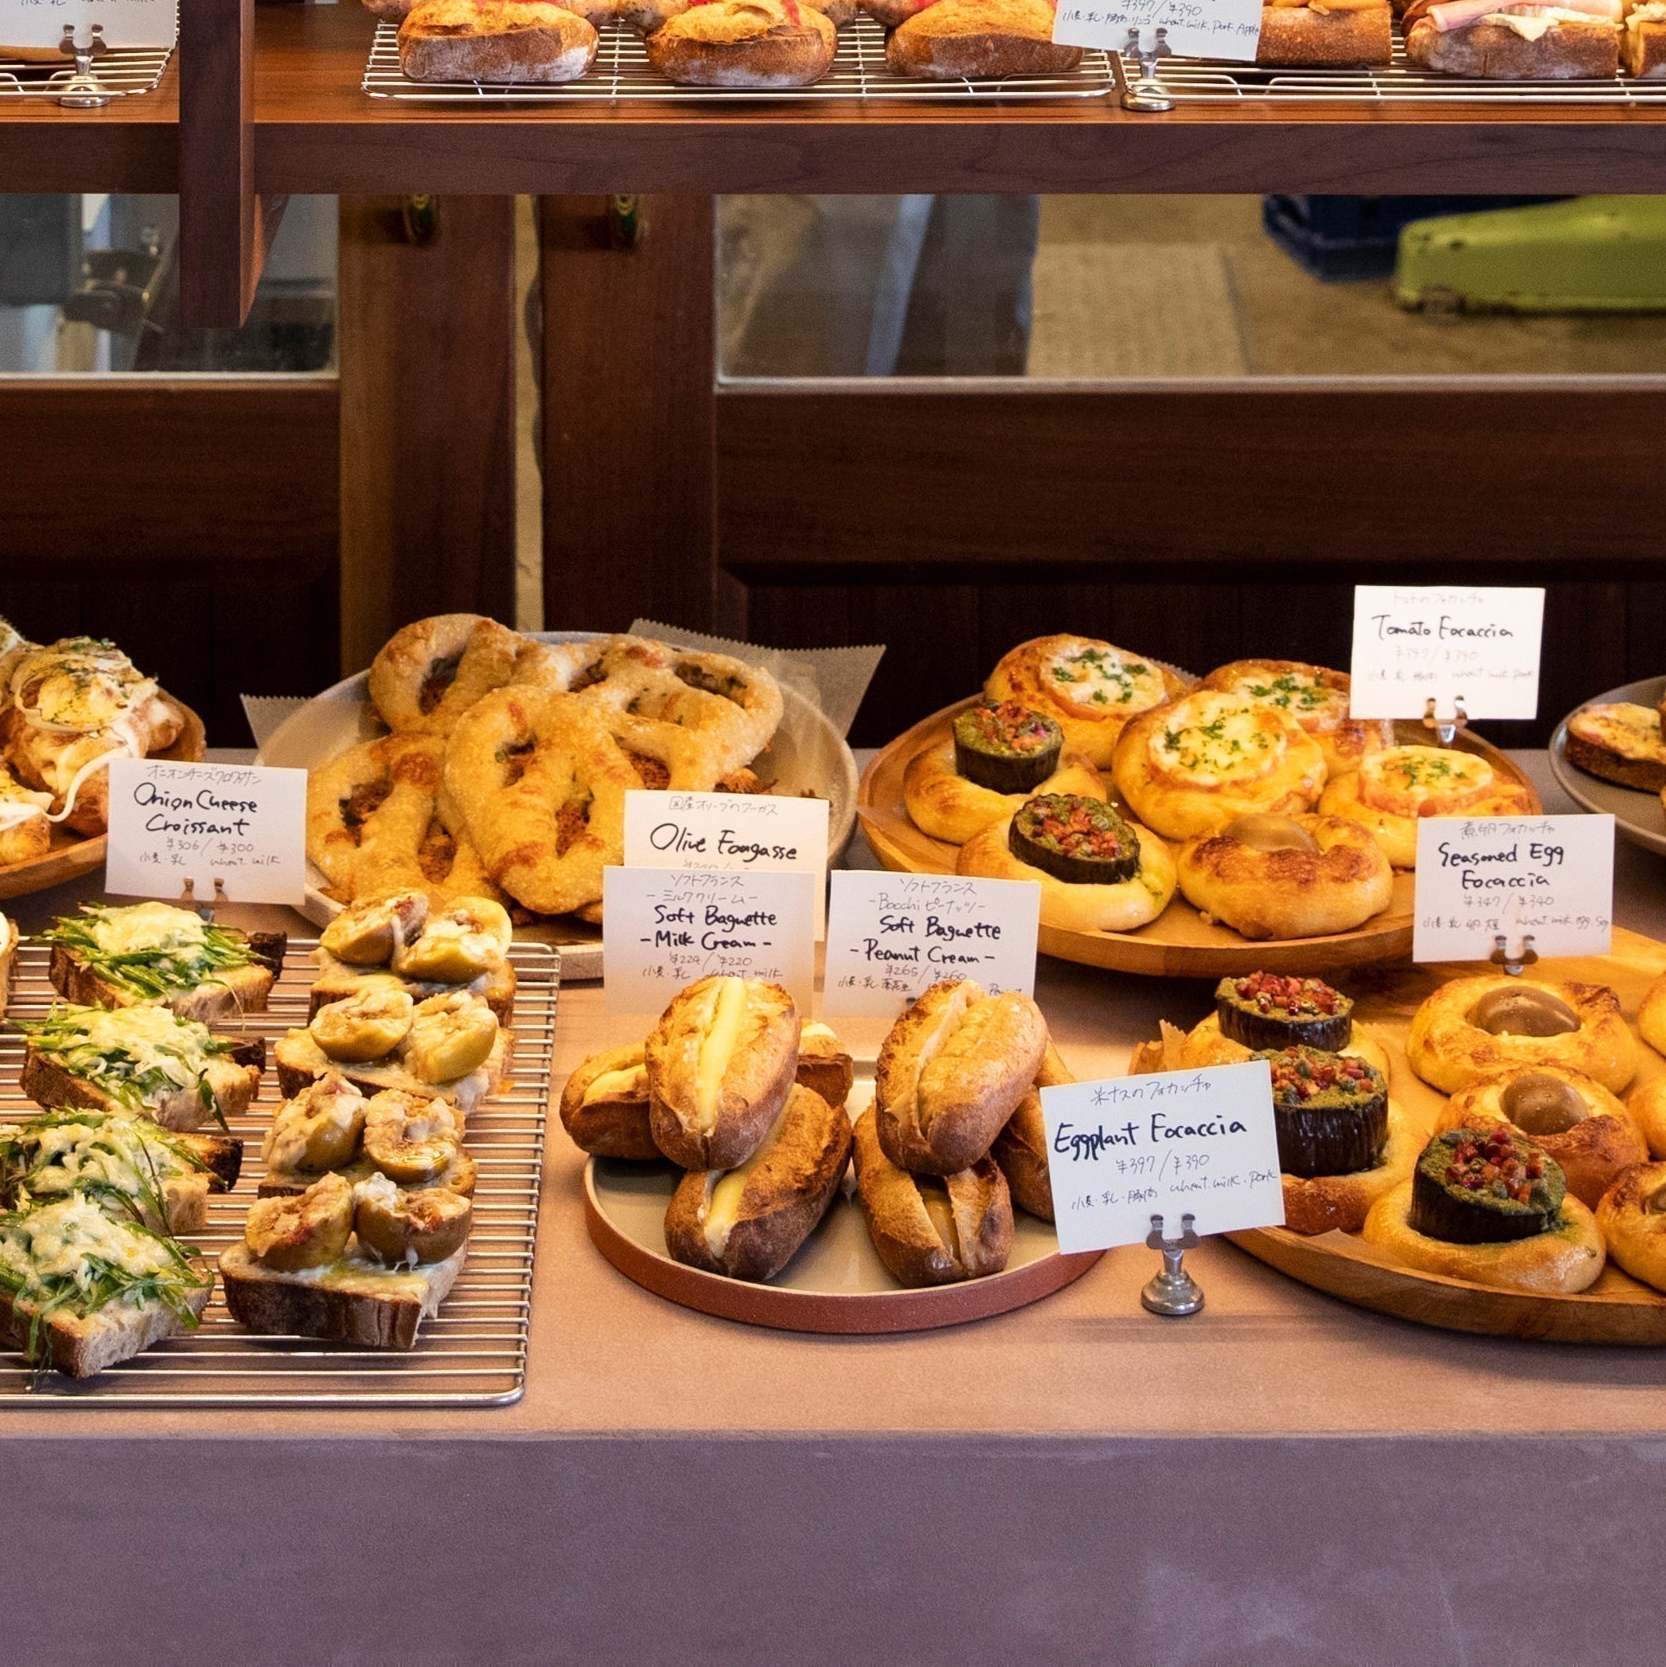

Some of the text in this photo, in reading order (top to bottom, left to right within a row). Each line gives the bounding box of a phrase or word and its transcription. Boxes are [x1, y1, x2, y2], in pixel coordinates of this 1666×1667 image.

[1371, 614, 1514, 641] Tomato Focaccia
[134, 782, 257, 813] Onion Cheese
[146, 813, 250, 836] Croissant
[650, 822, 798, 863] Olive Fougasse
[1438, 842, 1564, 867] Seasoned Egg
[1462, 869, 1550, 890] Focaccia
[655, 905, 777, 932] Soft Baguette
[880, 915, 1001, 941] Soft Baguette
[655, 930, 756, 951] Milk Cream
[863, 938, 980, 963] Peanut Cream
[1054, 1113, 1247, 1161] Eggplant Focaccia
